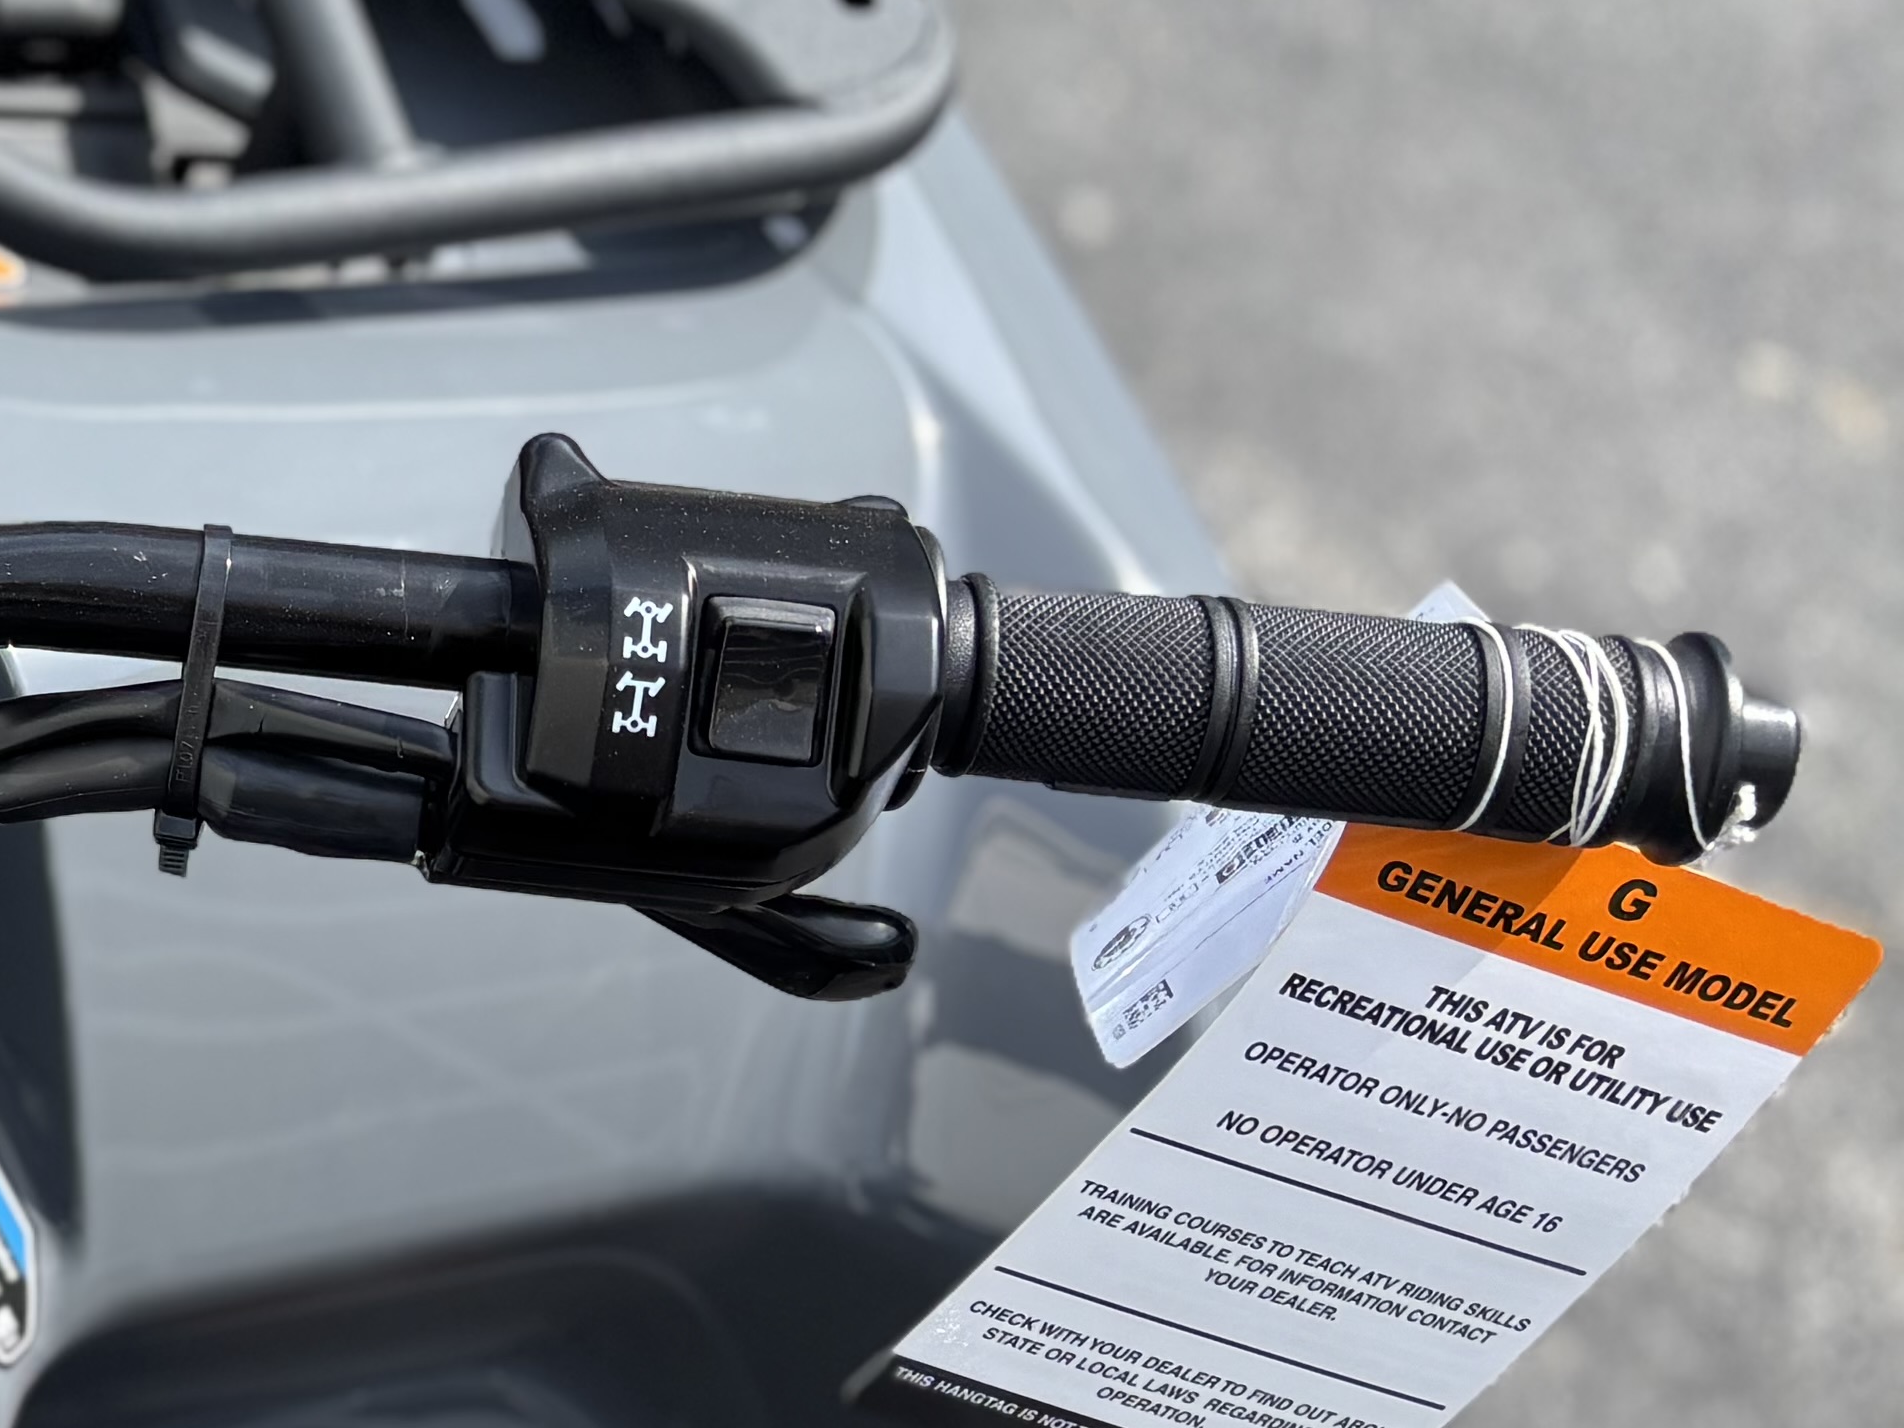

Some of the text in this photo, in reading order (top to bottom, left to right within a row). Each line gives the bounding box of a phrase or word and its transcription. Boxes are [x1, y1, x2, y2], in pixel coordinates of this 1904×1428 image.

[1378, 861, 1796, 1028] GENERAL USE MODEL
[1607, 879, 1658, 921] G
[1279, 975, 1722, 1133] RECREATIONAL USE OR UTILITY USE
[1425, 986, 1625, 1069] THIS ATV IS FOR
[1217, 1111, 1563, 1232] NO OPERATOR UNDER AGE 16
[1245, 1042, 1645, 1182] OPERATOR ONLY-NO PASSENGERS
[1079, 1206, 1497, 1343] ARE AVAILABLE. FOR INFORMATION CONTACT
[1081, 1180, 1531, 1331] TRAINING COURSES TO TEACH ATV RIDING SKILLS
[1205, 1268, 1337, 1320] YOUR DEALER.
[897, 1367, 934, 1387] THIS
[934, 1381, 1018, 1414] HANGTAG
[1018, 1408, 1038, 1420] IS
[970, 1301, 1040, 1331] CHECK
[1039, 1322, 1089, 1347] WITH
[1090, 1338, 1142, 1364] YOUR
[1142, 1357, 1221, 1389] DEALER
[1221, 1380, 1247, 1396] TO
[1247, 1389, 1293, 1410] FIND
[1294, 1404, 1337, 1423] OUT
[983, 1328, 1045, 1355] STATE
[1045, 1348, 1076, 1365] OR
[1076, 1358, 1138, 1386] LOCAL
[1142, 1379, 1199, 1403] LAWS
[1097, 1387, 1206, 1428] OPERATION.
